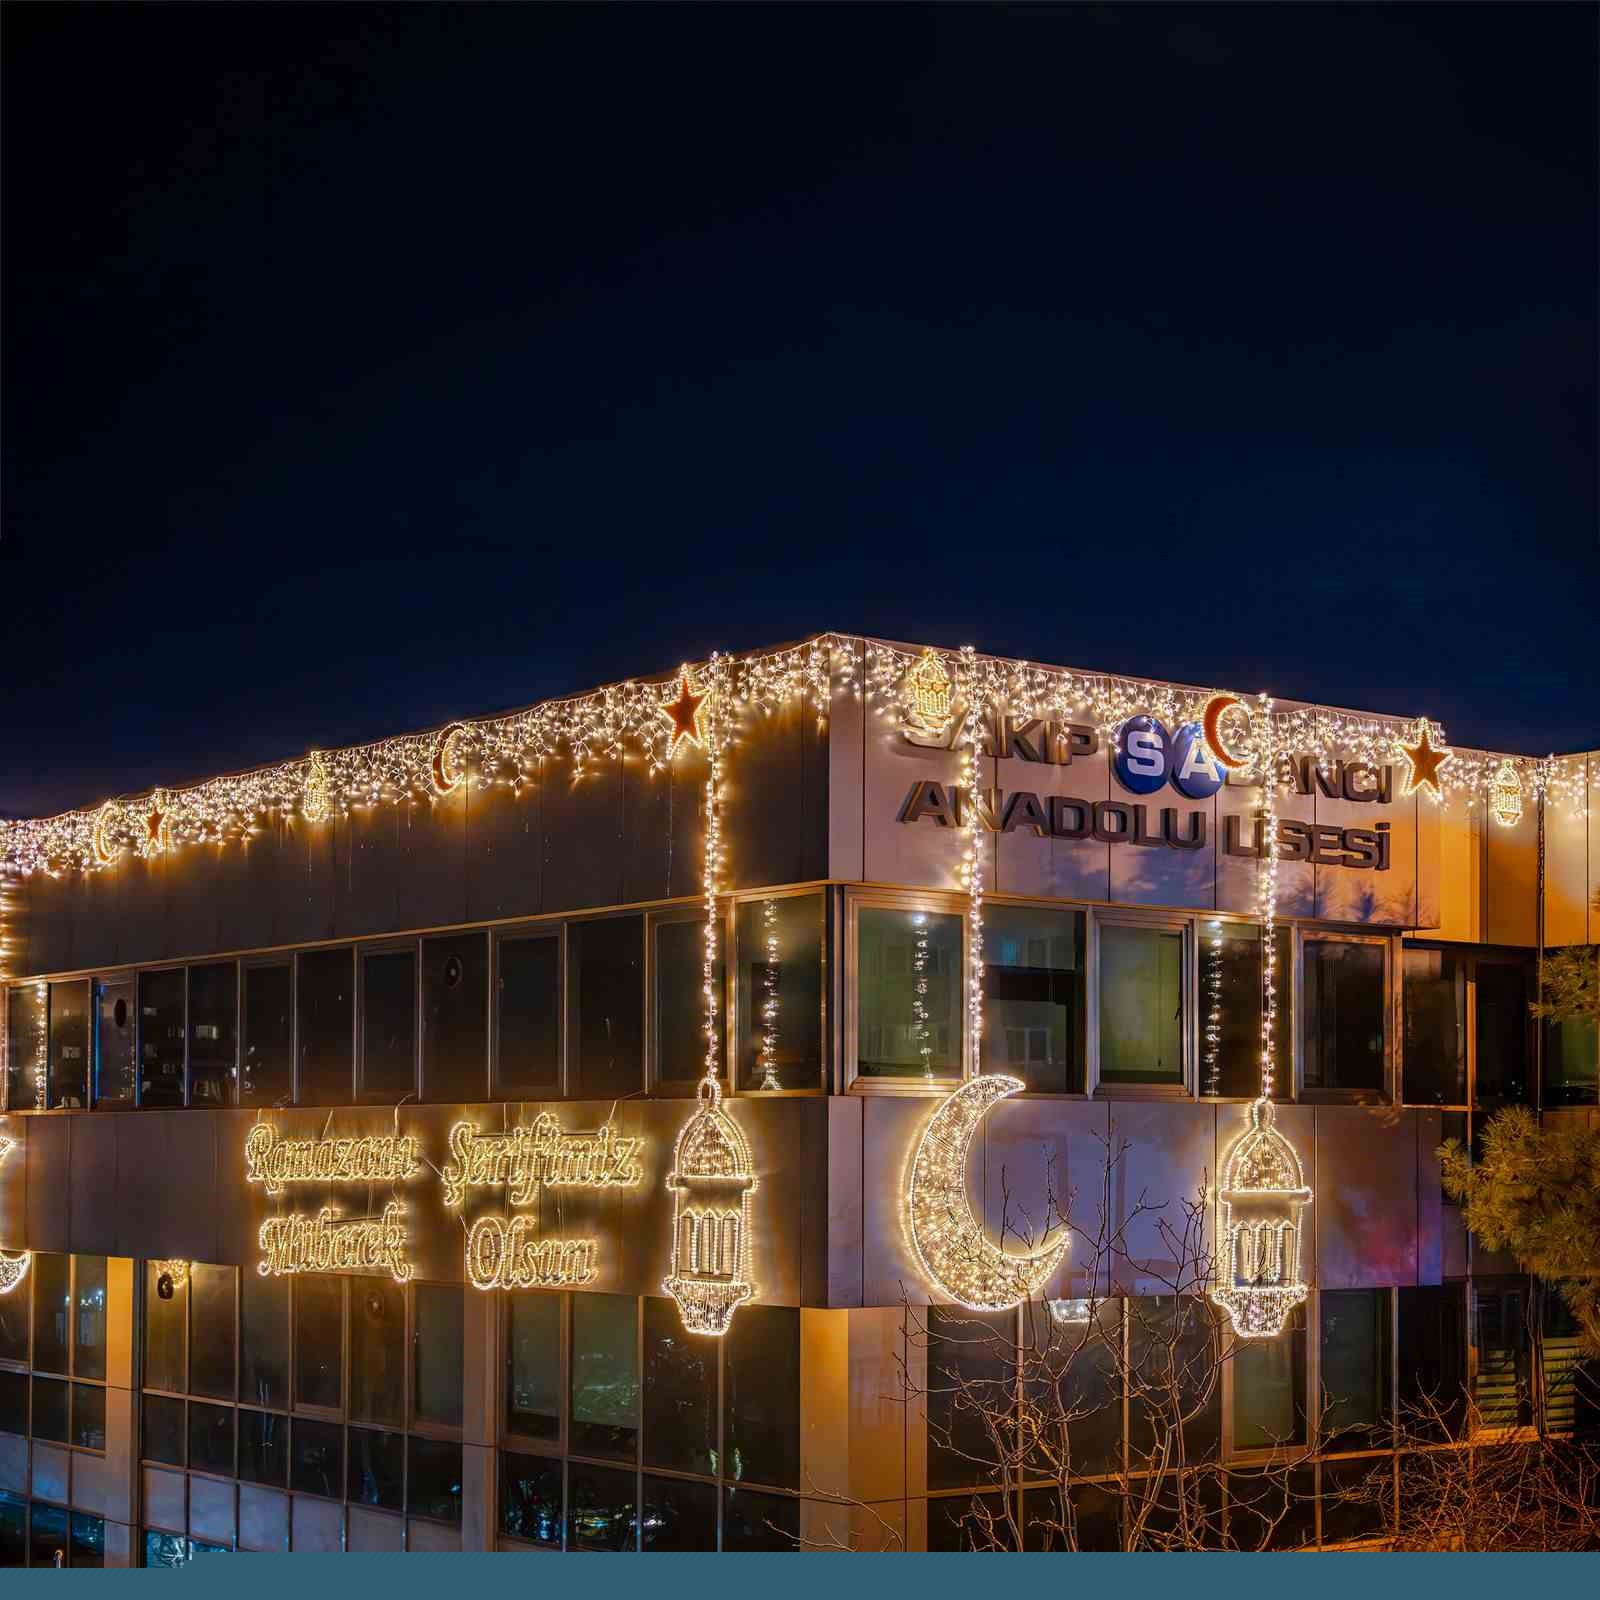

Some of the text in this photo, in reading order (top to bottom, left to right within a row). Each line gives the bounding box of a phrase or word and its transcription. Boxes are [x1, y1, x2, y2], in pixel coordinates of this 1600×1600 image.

[1120, 722, 1393, 804] SAANCI
[896, 780, 1206, 850] ANADOLU
[466, 1215, 600, 1290] Olsun
